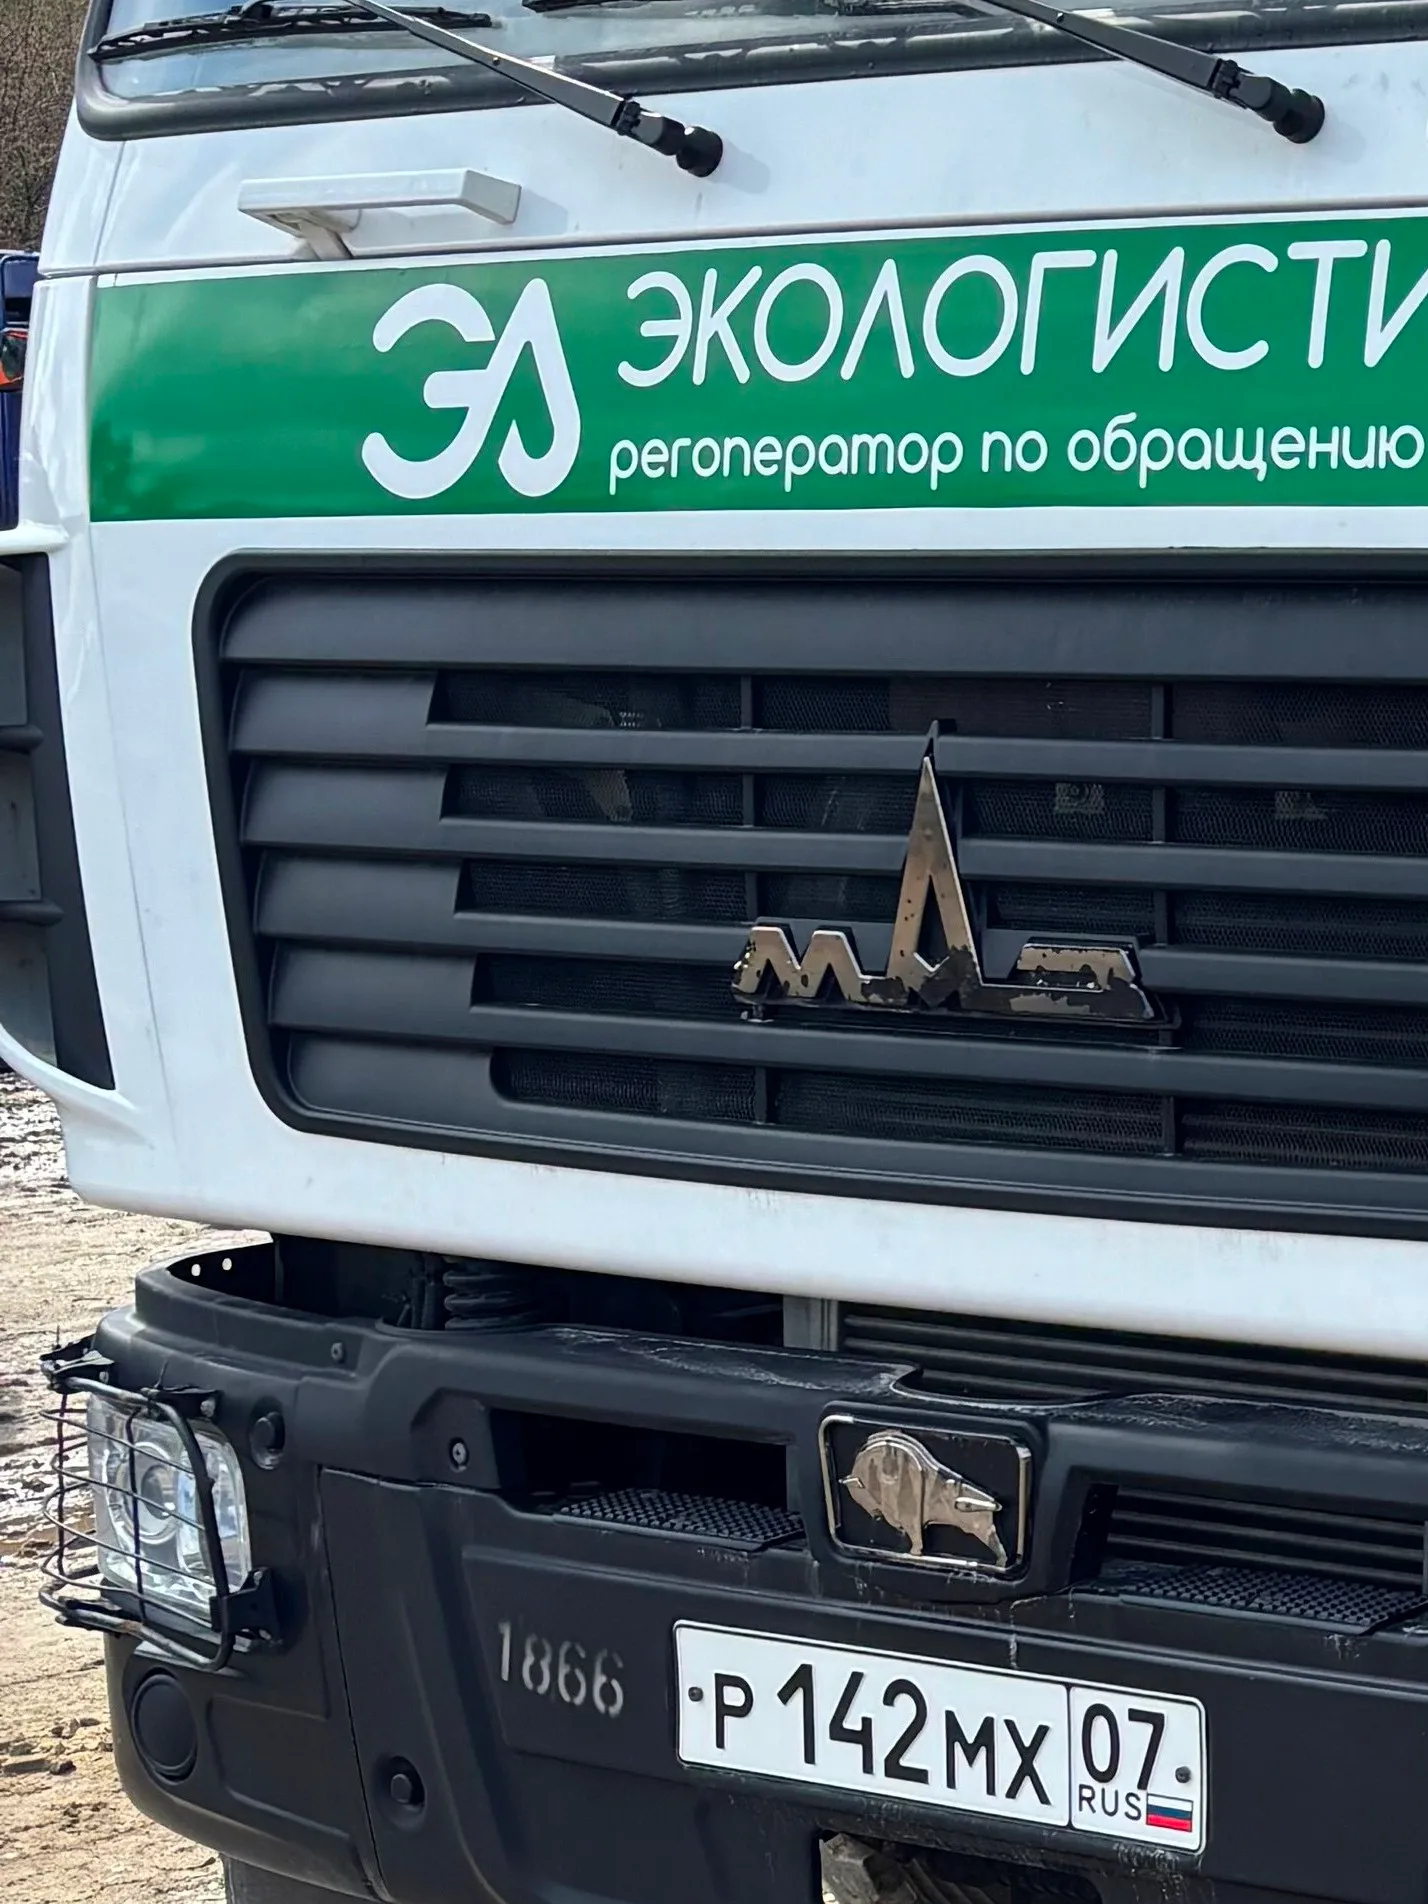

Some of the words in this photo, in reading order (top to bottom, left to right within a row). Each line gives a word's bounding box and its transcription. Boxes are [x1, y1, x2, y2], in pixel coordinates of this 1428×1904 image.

[610, 430, 964, 495] регоператор
[981, 430, 1048, 473] по
[1067, 412, 1425, 489] обращению
[495, 1621, 625, 1718] 1866
[1081, 1703, 1165, 1791] 07
[1078, 1784, 1142, 1821] RUS
